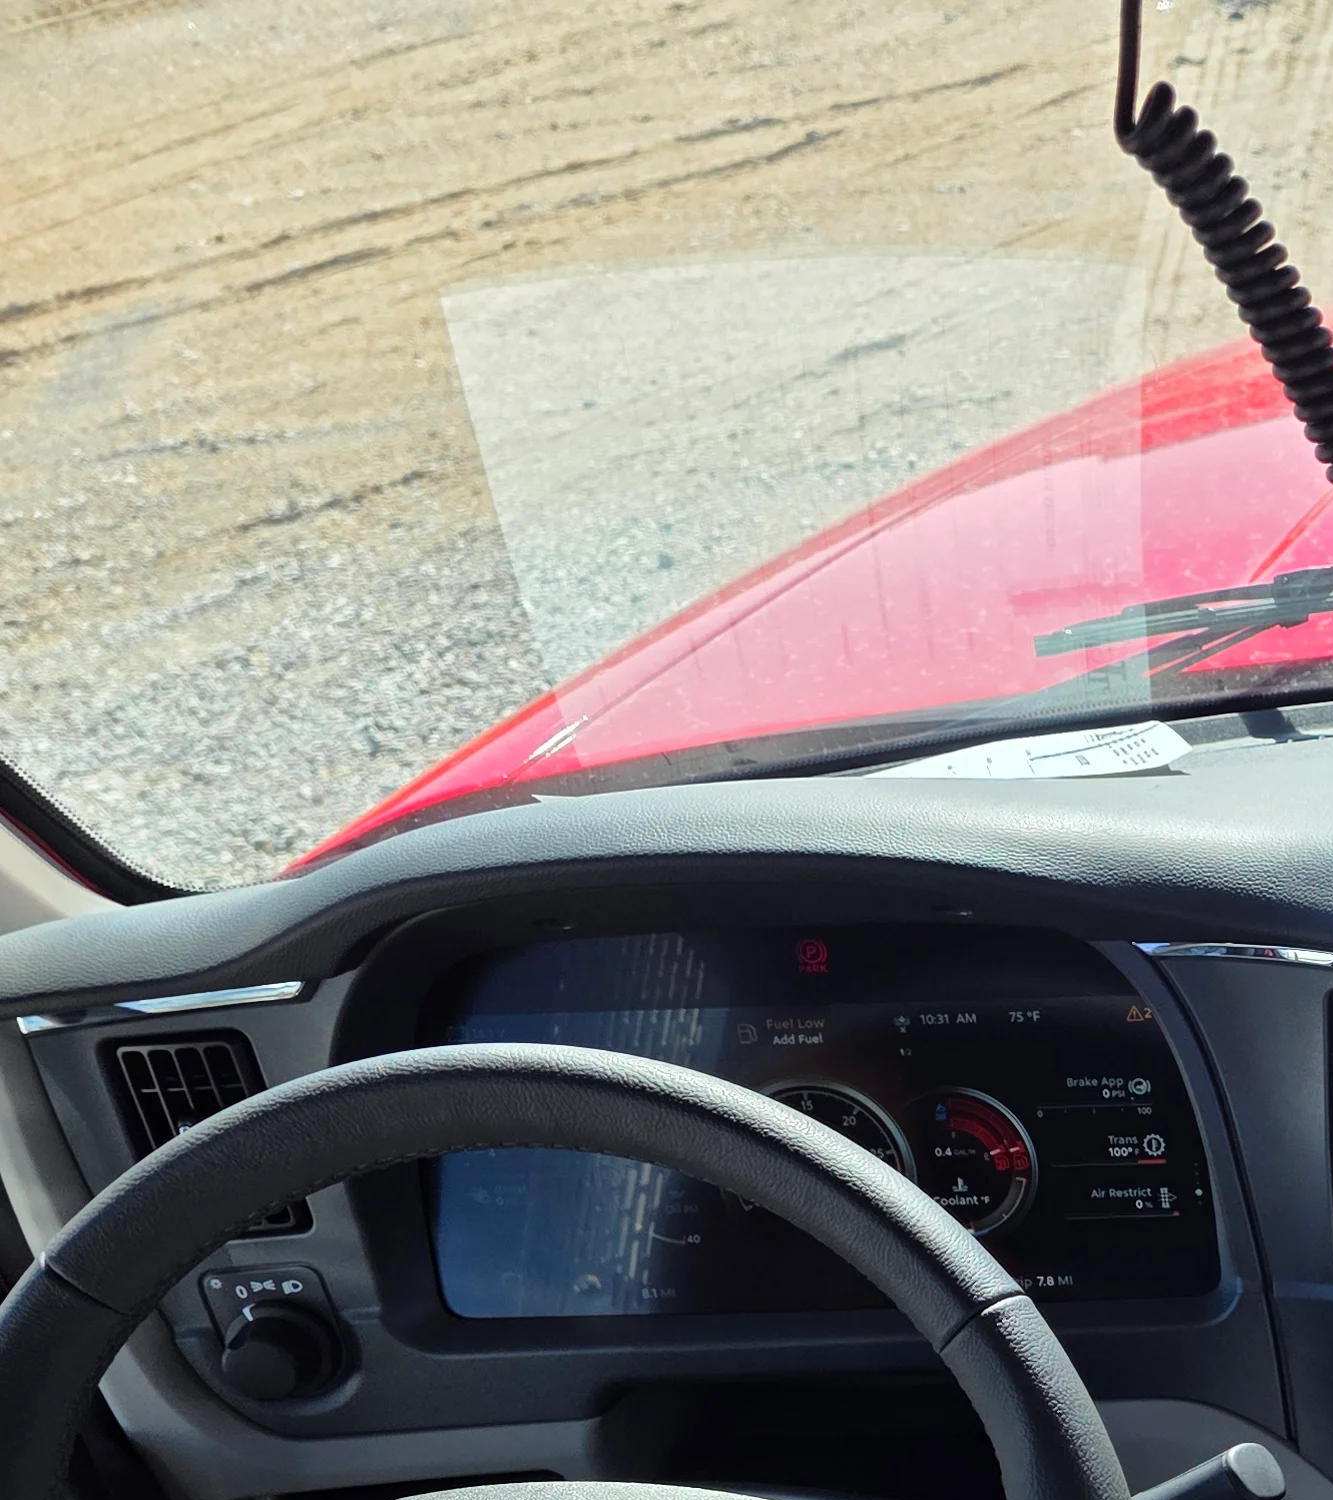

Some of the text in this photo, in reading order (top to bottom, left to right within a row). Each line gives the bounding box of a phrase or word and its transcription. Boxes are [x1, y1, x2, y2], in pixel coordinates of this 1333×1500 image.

[920, 1013, 977, 1025] 10:31 AM
[1009, 1011, 1041, 1022] 75 °F
[766, 1018, 824, 1030] Fuel Low
[773, 1033, 823, 1045] Add Fuel
[1066, 1077, 1124, 1088] Brake App
[1112, 1090, 1125, 1098] PSI
[1137, 1106, 1152, 1115] 100
[842, 1116, 857, 1126] 20
[1108, 1136, 1138, 1144] Trans
[935, 1147, 952, 1157] 0.4
[1091, 1187, 1152, 1198] Air Restrict
[933, 1195, 978, 1206] Coolant
[687, 1234, 700, 1244] 40
[1036, 1276, 1074, 1287] 7.8 MI
